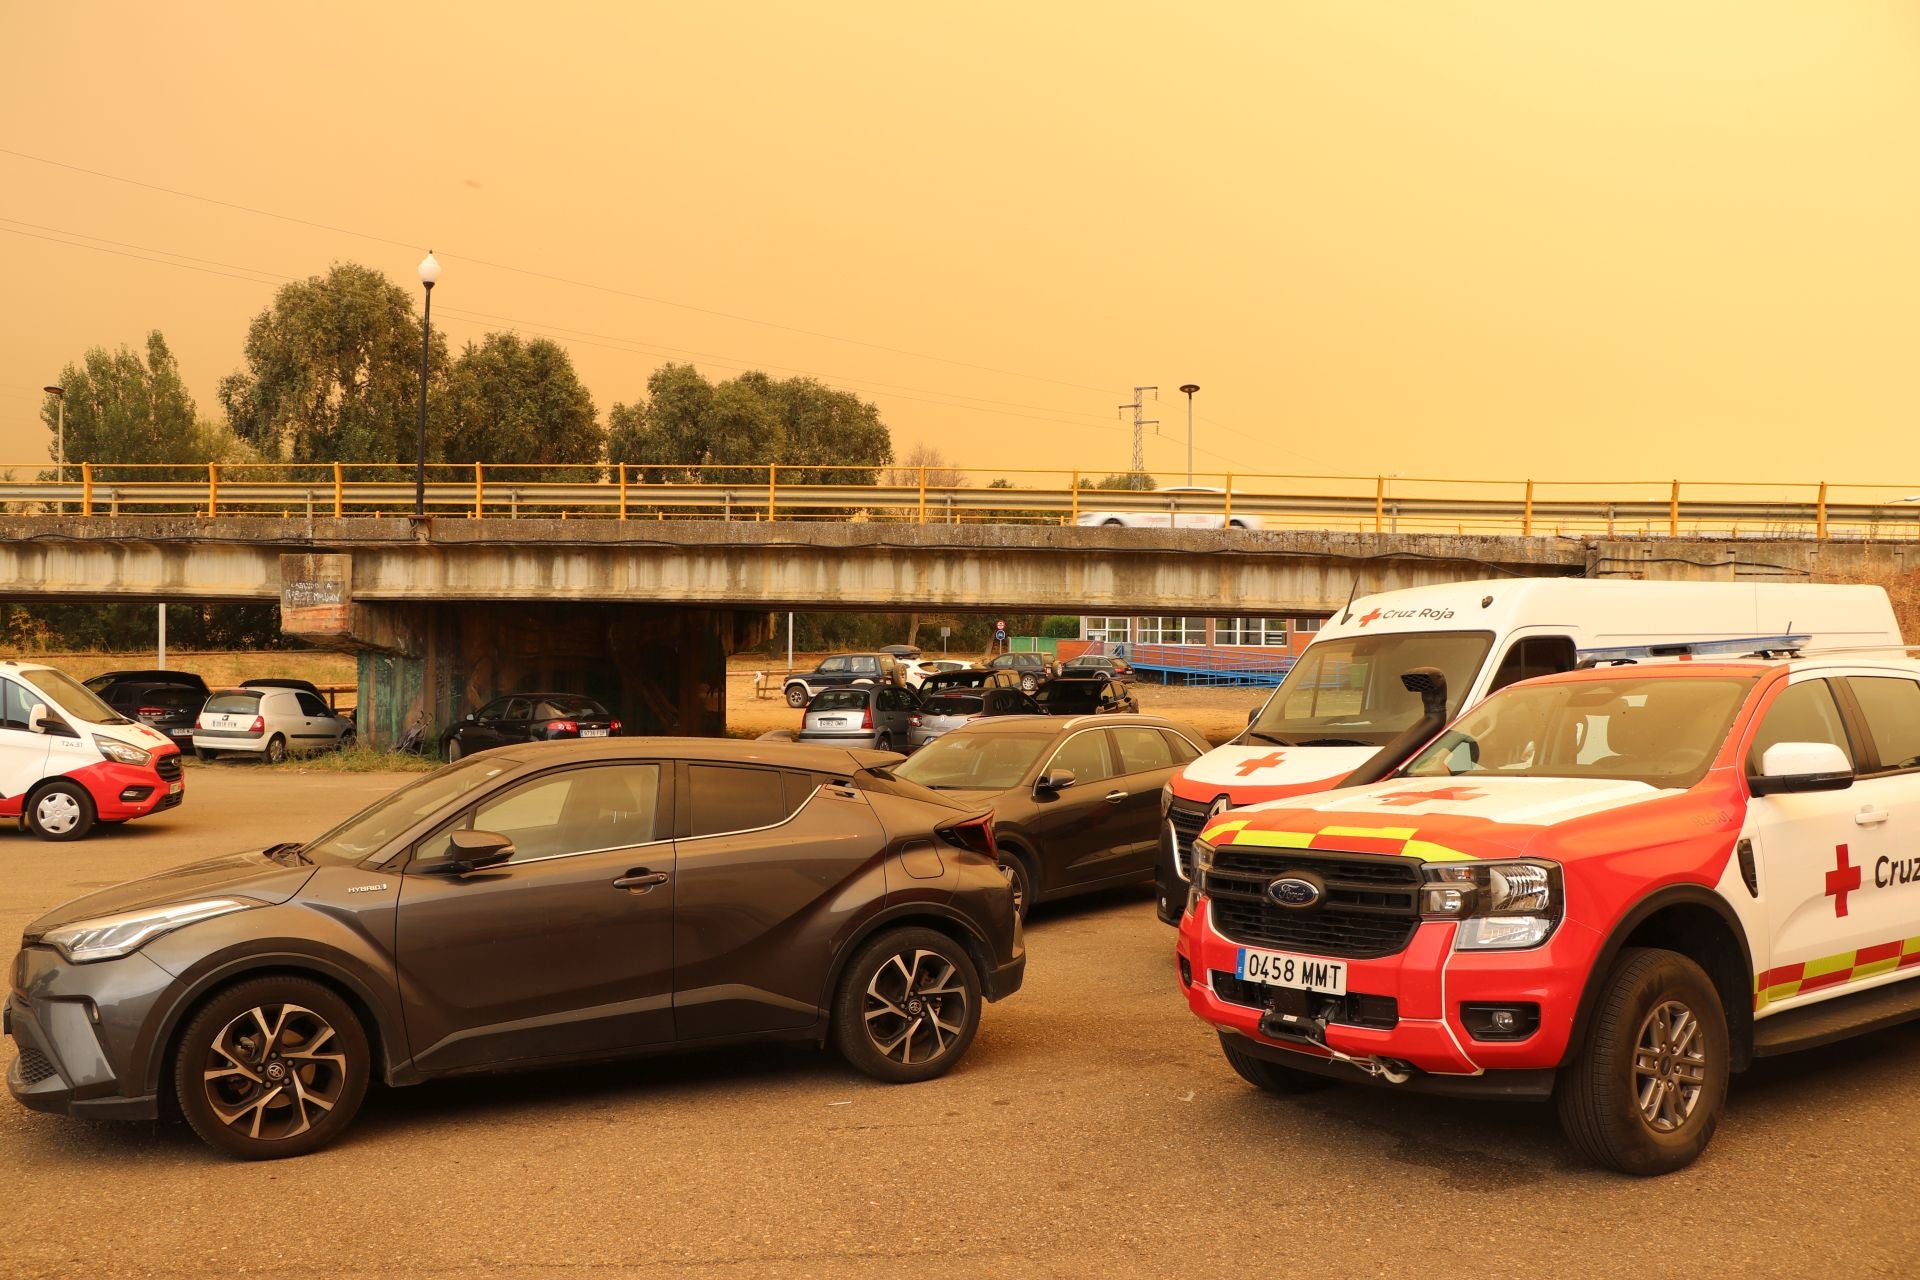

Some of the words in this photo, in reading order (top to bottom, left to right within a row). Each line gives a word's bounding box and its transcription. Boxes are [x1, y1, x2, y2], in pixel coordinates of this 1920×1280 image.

[1382, 608, 1417, 619] Cruz
[1418, 607, 1455, 621] Roja
[1875, 855, 1920, 889] Cruz
[1249, 954, 1295, 982] 0458
[1301, 961, 1342, 989] MMT
